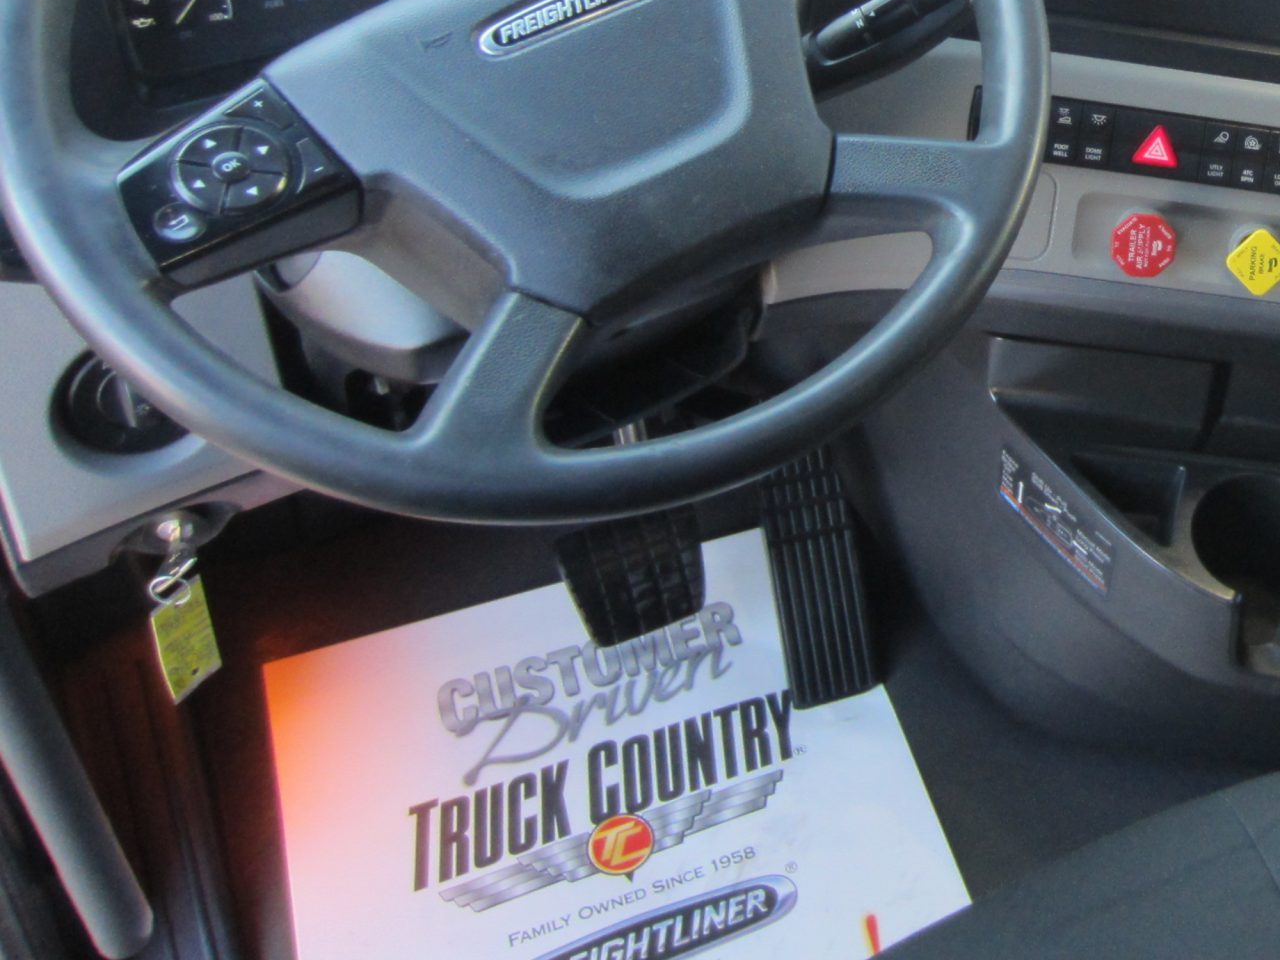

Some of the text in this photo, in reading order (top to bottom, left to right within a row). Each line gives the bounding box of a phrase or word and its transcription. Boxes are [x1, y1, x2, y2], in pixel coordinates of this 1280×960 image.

[221, 159, 240, 173] OK
[437, 601, 743, 737] CUSTOMER
[463, 640, 734, 787] Driven
[408, 689, 795, 893] TRUCK COUNTRY
[508, 846, 757, 948] FAMILY OWNED SINCE 1958
